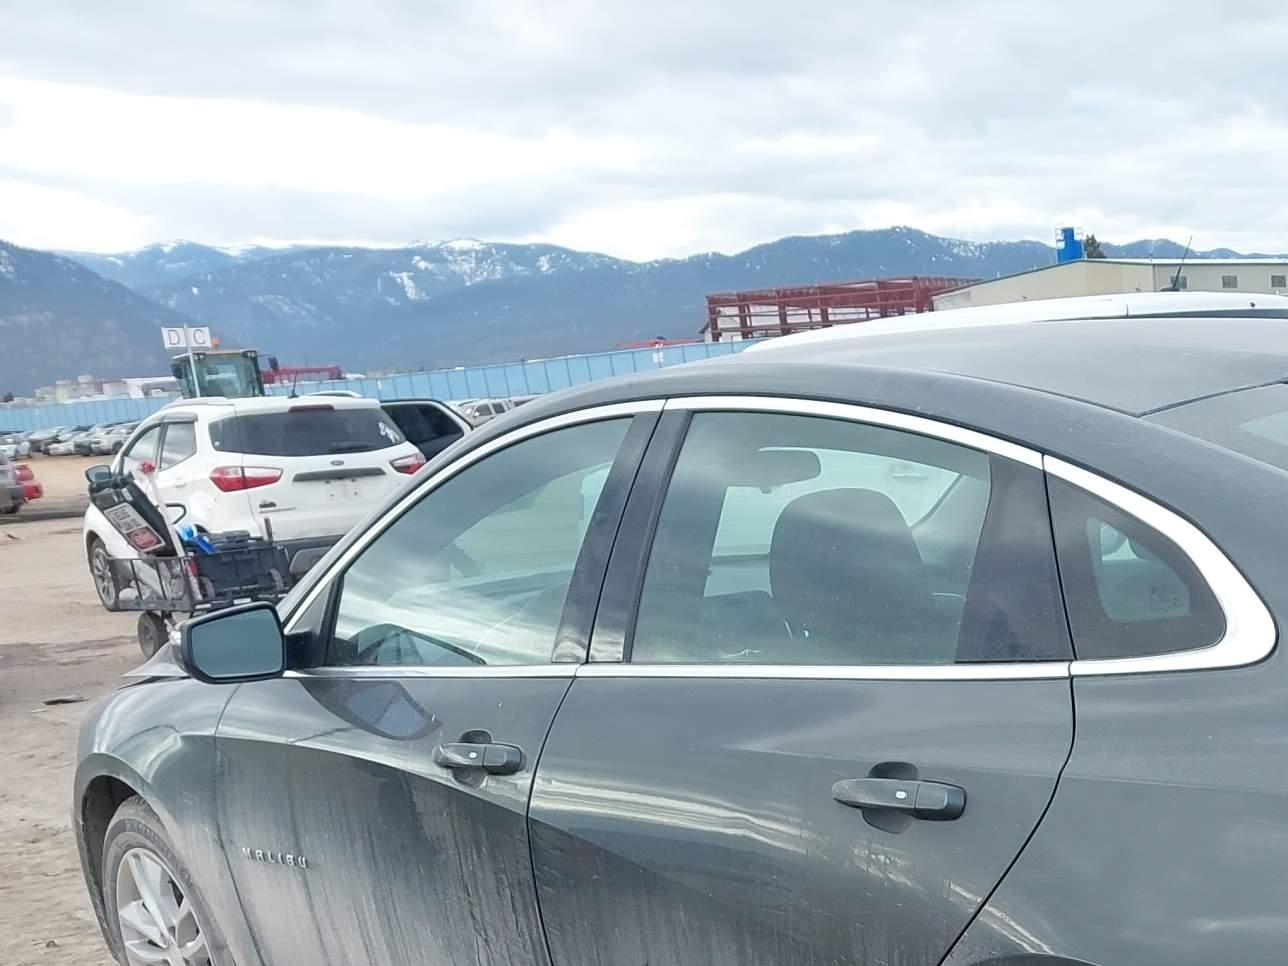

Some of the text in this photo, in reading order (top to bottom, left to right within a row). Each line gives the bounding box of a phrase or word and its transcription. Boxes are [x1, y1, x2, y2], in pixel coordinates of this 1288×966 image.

[167, 328, 206, 345] D C
[242, 847, 308, 868] MALIBU
